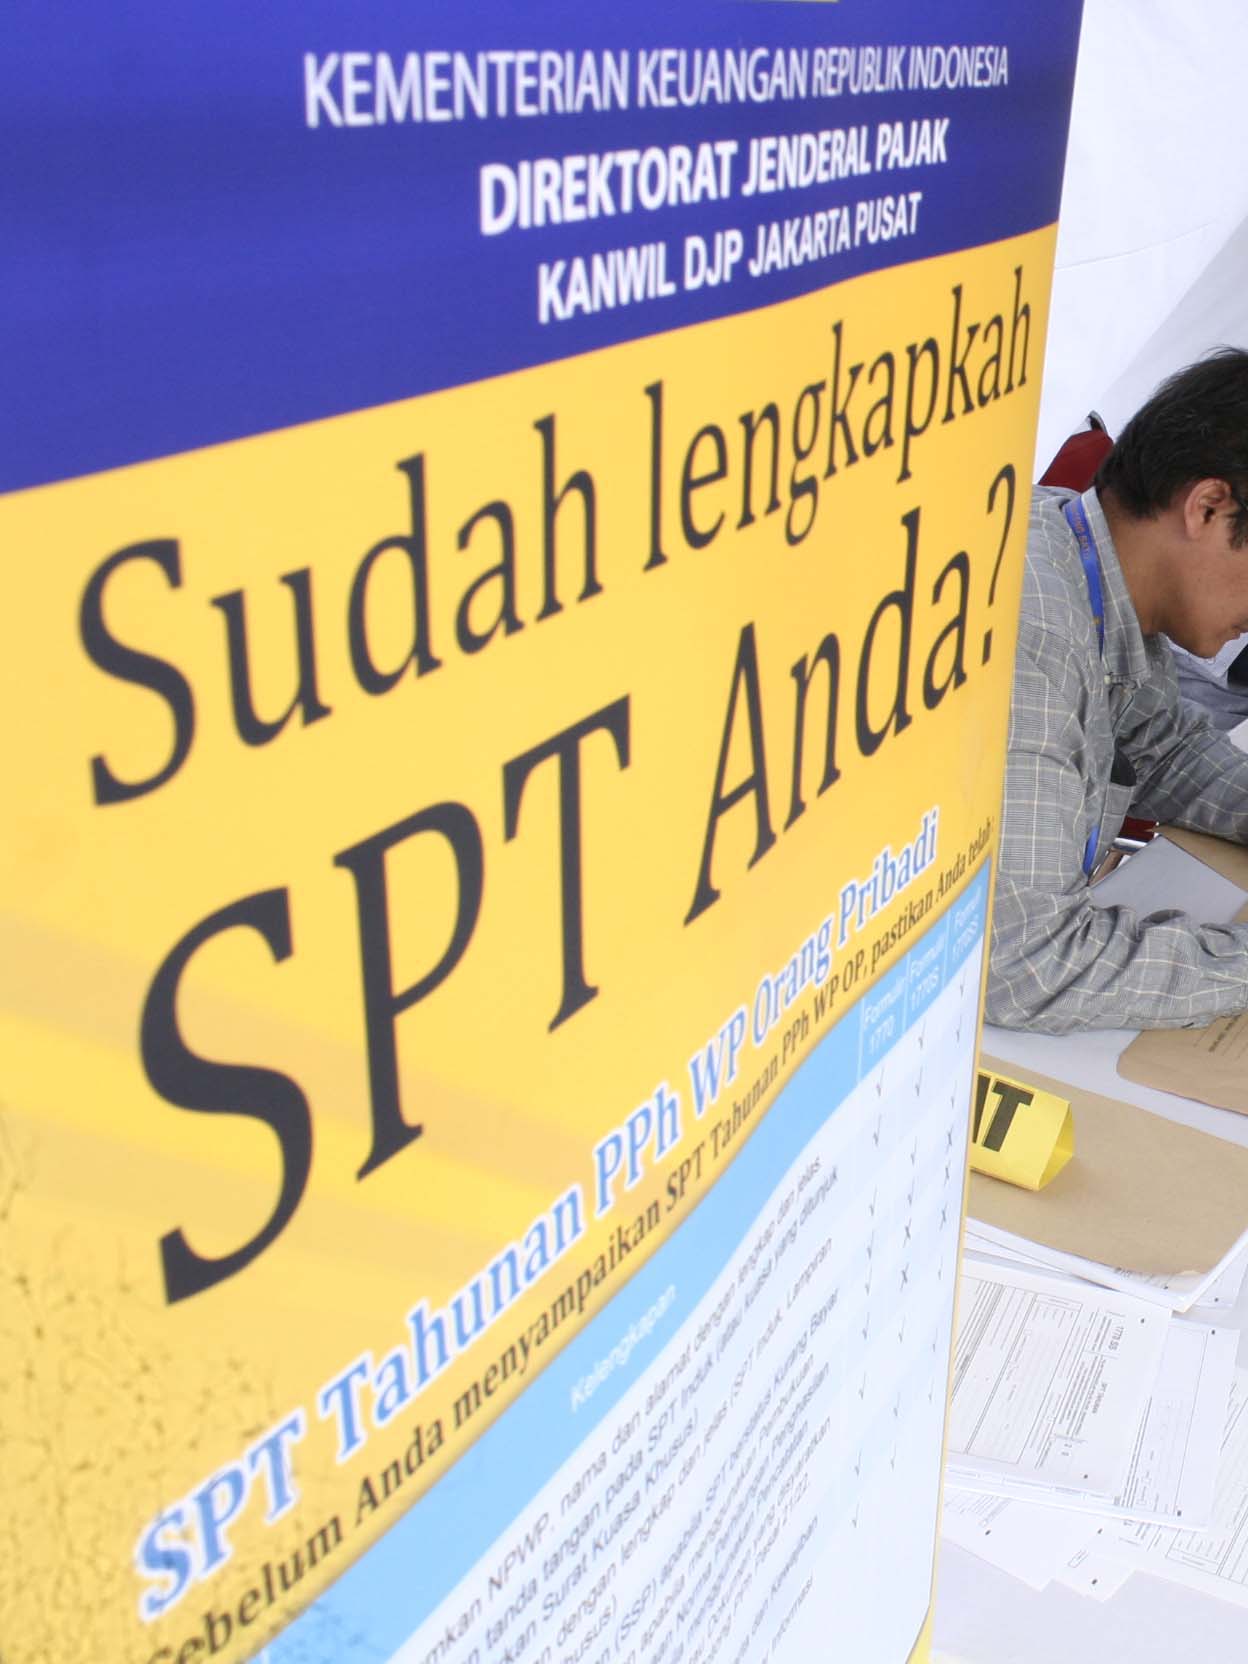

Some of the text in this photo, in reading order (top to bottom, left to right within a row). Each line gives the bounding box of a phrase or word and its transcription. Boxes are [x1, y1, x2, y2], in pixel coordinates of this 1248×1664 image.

[303, 44, 1009, 128] KEMENTERIAN KEUANGAN REPUBLIK INDONESIA
[479, 118, 950, 237] DIREKTORAT JENDERAL PAJAK
[537, 192, 923, 325] KANWIL DJP JAKARTA PUSAT
[76, 265, 1030, 808] Sudah lengkapkah
[138, 463, 1016, 1306] SPT Anda?
[138, 807, 938, 1617] SPT Tahunan PPh WP Orang Pribadi
[354, 1424, 445, 1528] Anda
[452, 1199, 661, 1432] menyampaikan
[665, 1142, 706, 1213] SPT
[709, 1055, 780, 1161] Tahunan
[782, 1014, 809, 1067] PPh
[813, 975, 840, 1021] WP
[842, 949, 867, 994] OP,
[871, 890, 933, 975] pastikan
[935, 852, 966, 904] Anda
[561, 1451, 607, 1516] nama
[612, 1411, 640, 1454] dan
[645, 1343, 691, 1416] alamat
[694, 1282, 736, 1352] dengan
[738, 1220, 775, 1287] lengkap
[777, 1189, 795, 1225] dan
[570, 1284, 676, 1413] Kelengkapan
[485, 1578, 537, 1650] tanda
[542, 1502, 600, 1582] tangan
[605, 1449, 643, 1513] pada
[648, 1398, 676, 1453] SPT
[542, 1552, 588, 1623] Surat
[592, 1489, 640, 1561] Kuasa
[646, 1407, 699, 1495] Khusus)
[556, 1562, 617, 1647] dengan
[621, 1483, 675, 1566] lengkap
[679, 1444, 701, 1486] dan
[614, 1577, 656, 1653] (SSP)
[660, 1510, 702, 1585] apabila
